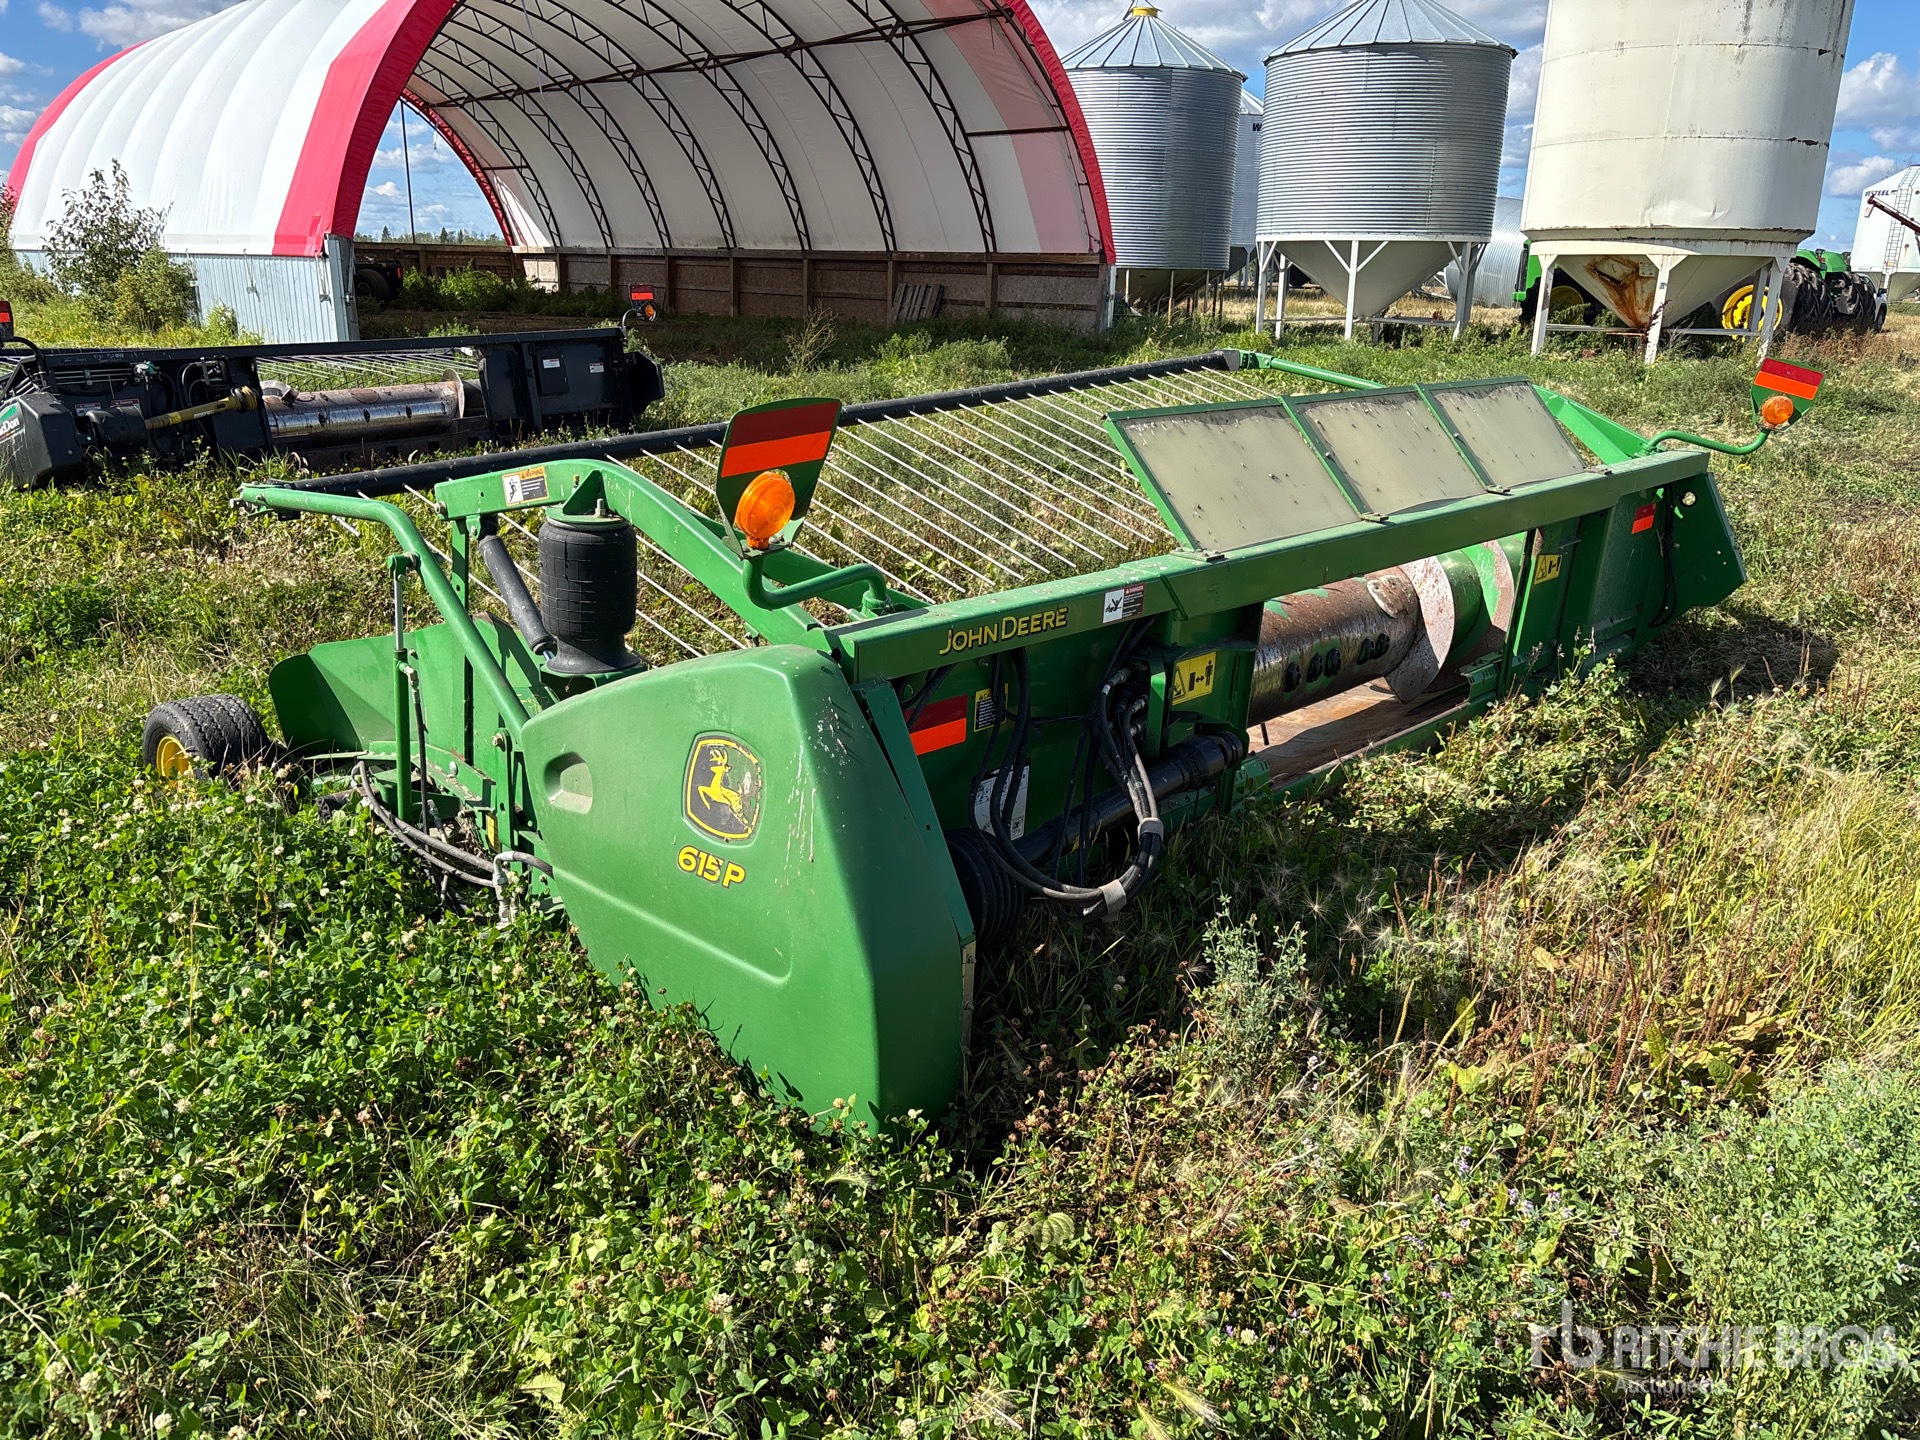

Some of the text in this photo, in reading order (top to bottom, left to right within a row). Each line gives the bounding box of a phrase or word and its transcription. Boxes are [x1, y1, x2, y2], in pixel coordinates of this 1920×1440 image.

[938, 606, 1069, 655] JOHN DEERE
[678, 845, 746, 888] 615P
